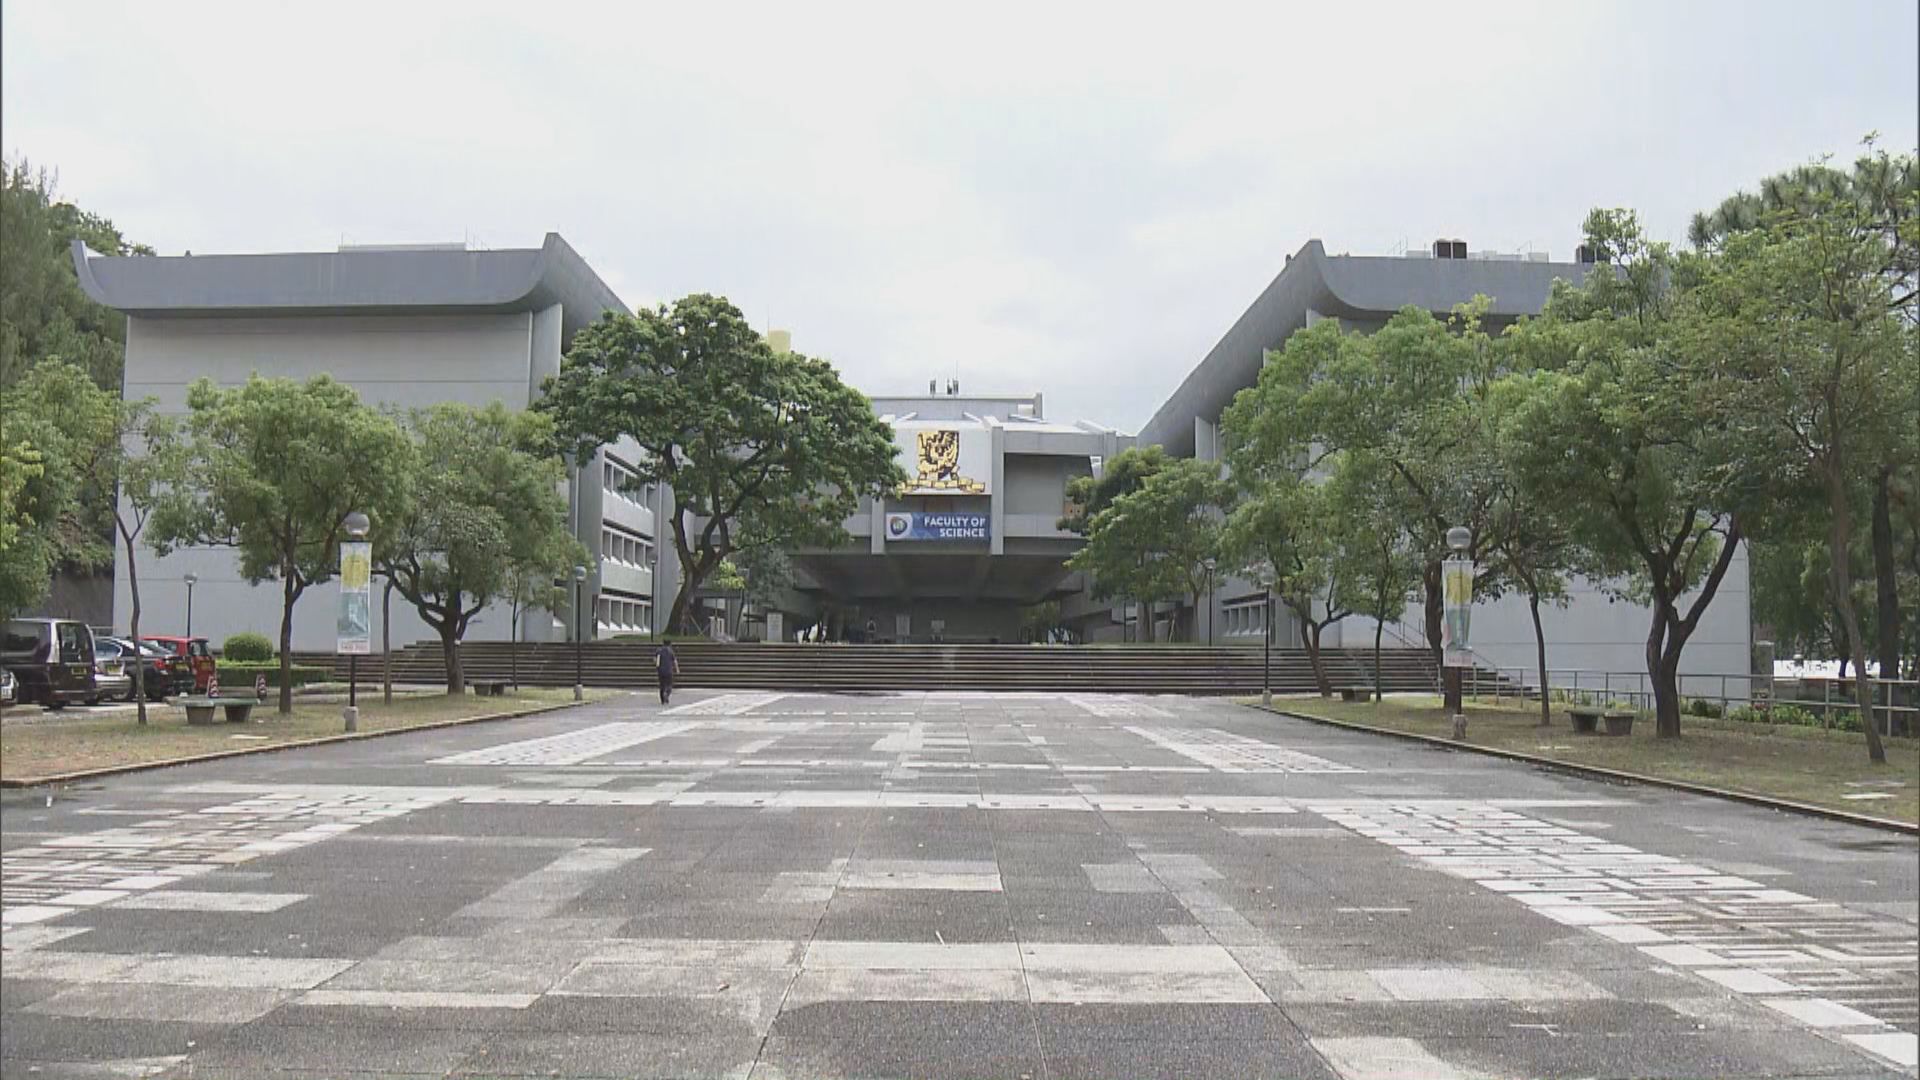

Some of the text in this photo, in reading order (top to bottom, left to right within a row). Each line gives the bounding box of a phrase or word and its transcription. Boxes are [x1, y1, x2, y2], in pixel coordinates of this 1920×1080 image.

[924, 516, 986, 527] FACULTY OF
[939, 528, 985, 538] SCIENCE
